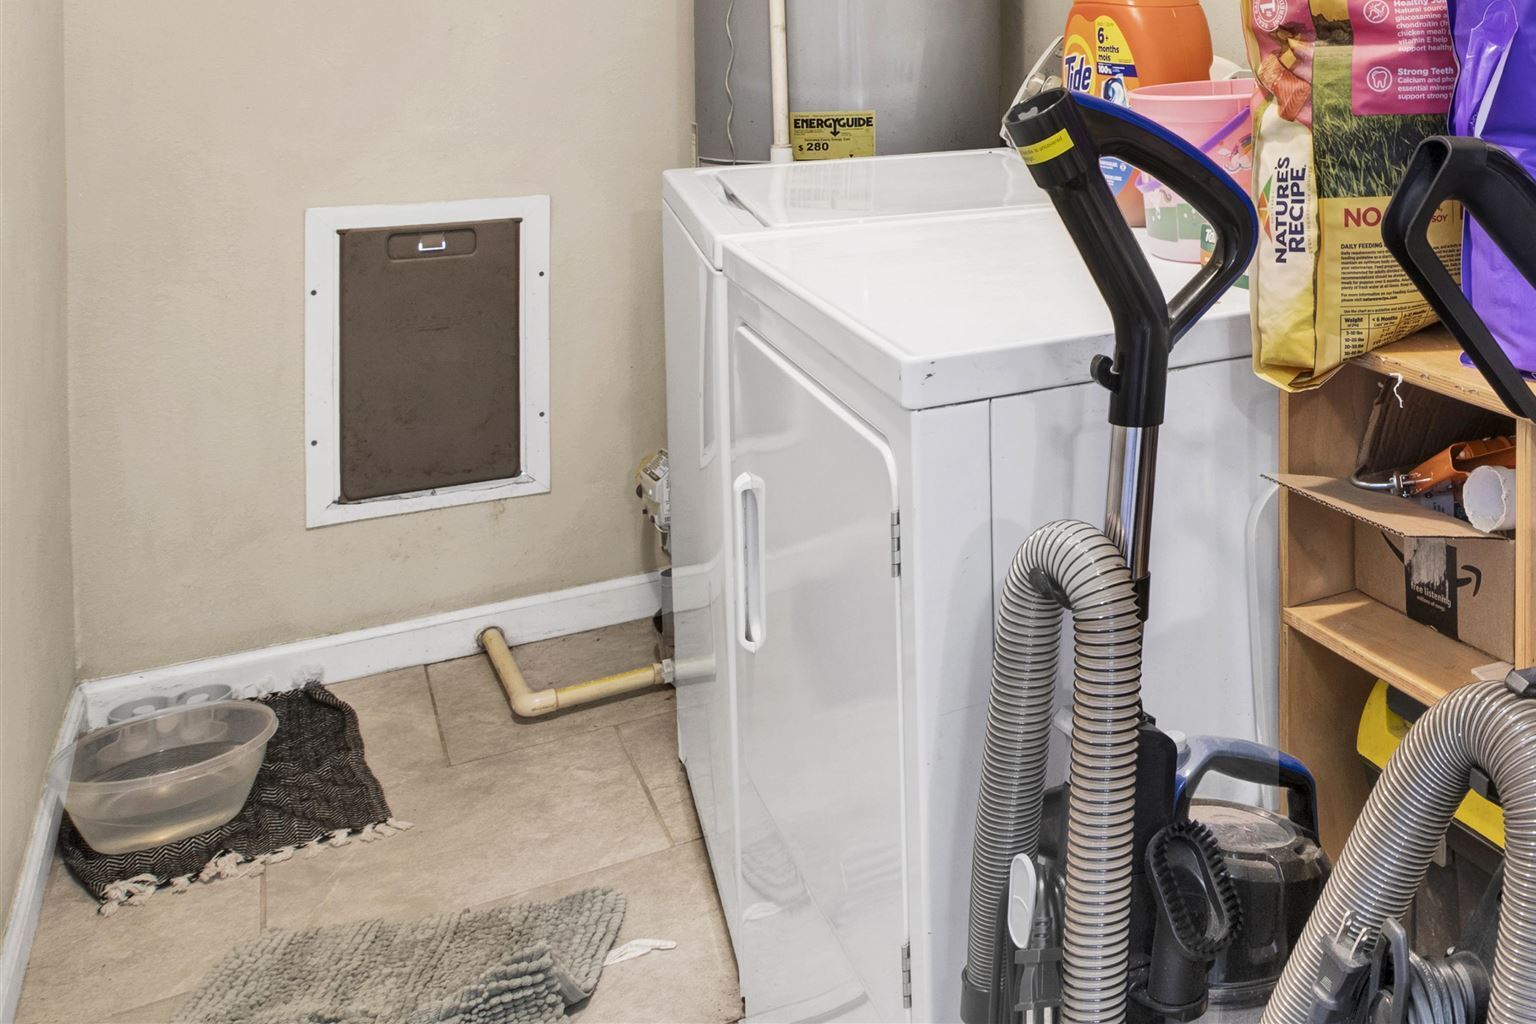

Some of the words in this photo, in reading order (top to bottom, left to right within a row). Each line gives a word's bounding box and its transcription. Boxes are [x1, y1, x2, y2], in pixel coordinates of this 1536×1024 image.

[1098, 45, 1119, 54] months
[1065, 54, 1092, 92] Tide
[1398, 68, 1429, 77] Strong
[1431, 67, 1454, 75] Teeth
[1427, 93, 1448, 101] strong
[794, 117, 873, 133] ENERGYGUIDE
[807, 143, 829, 151] 280
[1275, 156, 1290, 264] NATURE'S
[1343, 207, 1382, 228] NO
[1424, 587, 1451, 608] listening
